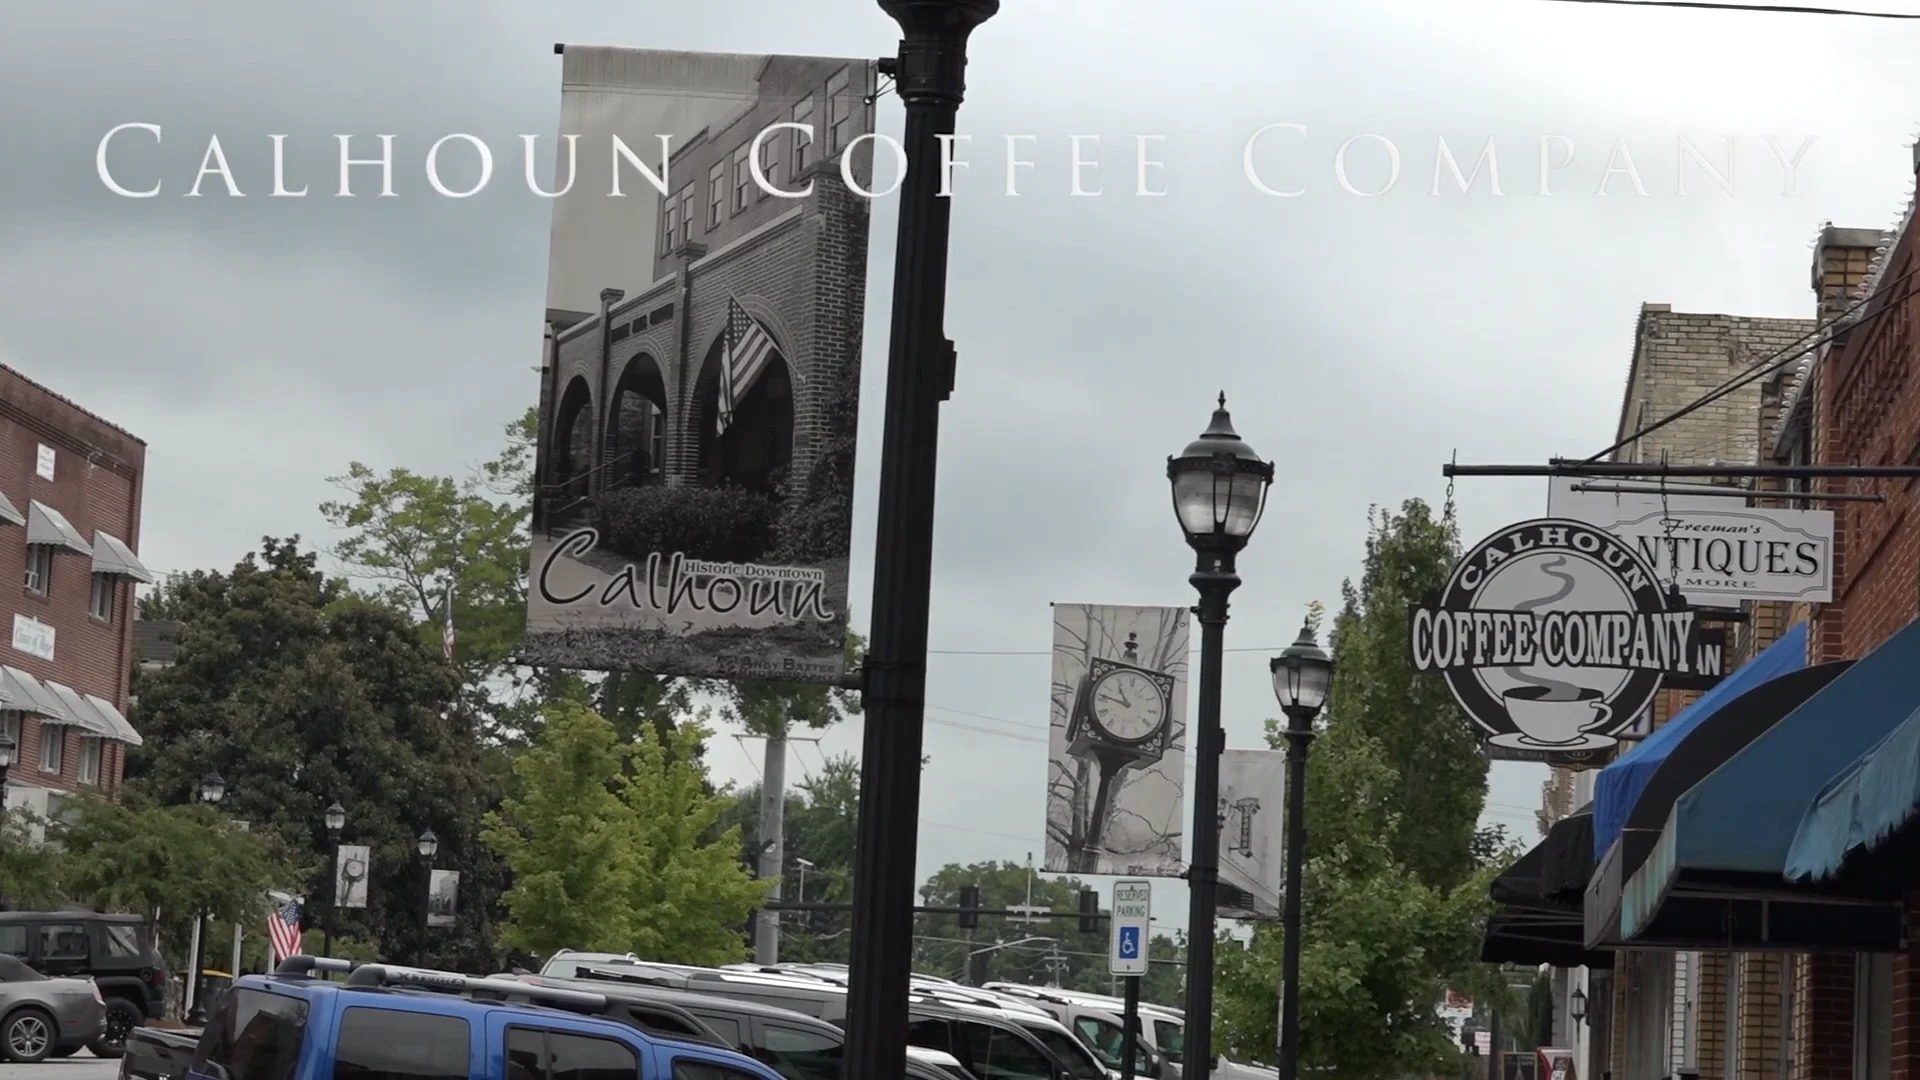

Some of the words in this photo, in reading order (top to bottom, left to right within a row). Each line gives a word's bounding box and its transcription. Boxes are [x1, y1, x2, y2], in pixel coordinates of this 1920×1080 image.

[1659, 518, 1762, 535] Freeman's
[1460, 527, 1650, 592] CALHOUN
[1616, 533, 1819, 577] NTIQUES
[538, 528, 834, 620] Calhoun
[684, 560, 741, 576] Historic
[744, 564, 823, 581] Downtown
[1685, 577, 1757, 588] MORE
[1413, 608, 1535, 671] COFFEE
[1544, 610, 1694, 673] COMPANY
[1116, 889, 1149, 901] RESERVED
[1116, 905, 1146, 917] PARKING
